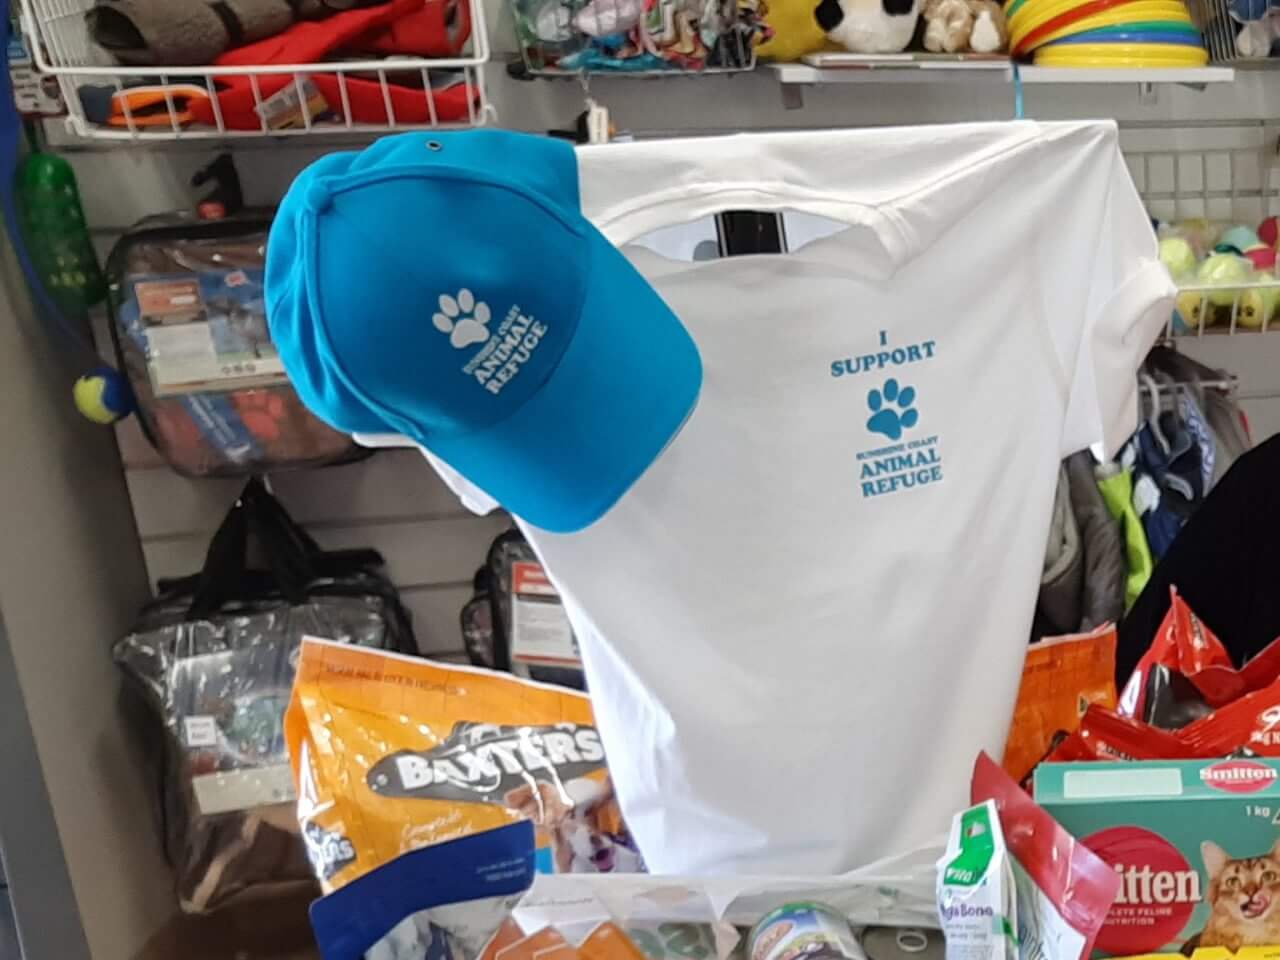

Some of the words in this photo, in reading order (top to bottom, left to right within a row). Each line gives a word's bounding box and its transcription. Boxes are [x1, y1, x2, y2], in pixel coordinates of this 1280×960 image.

[474, 314, 534, 385] ANIMAL
[879, 330, 888, 346] I
[485, 319, 548, 394] REFUGE
[830, 340, 936, 378] SUPPORT
[860, 448, 942, 480] ANIMAL
[861, 465, 943, 498] REFUGE
[1199, 766, 1278, 781] Smitten
[1114, 863, 1202, 905] itten
